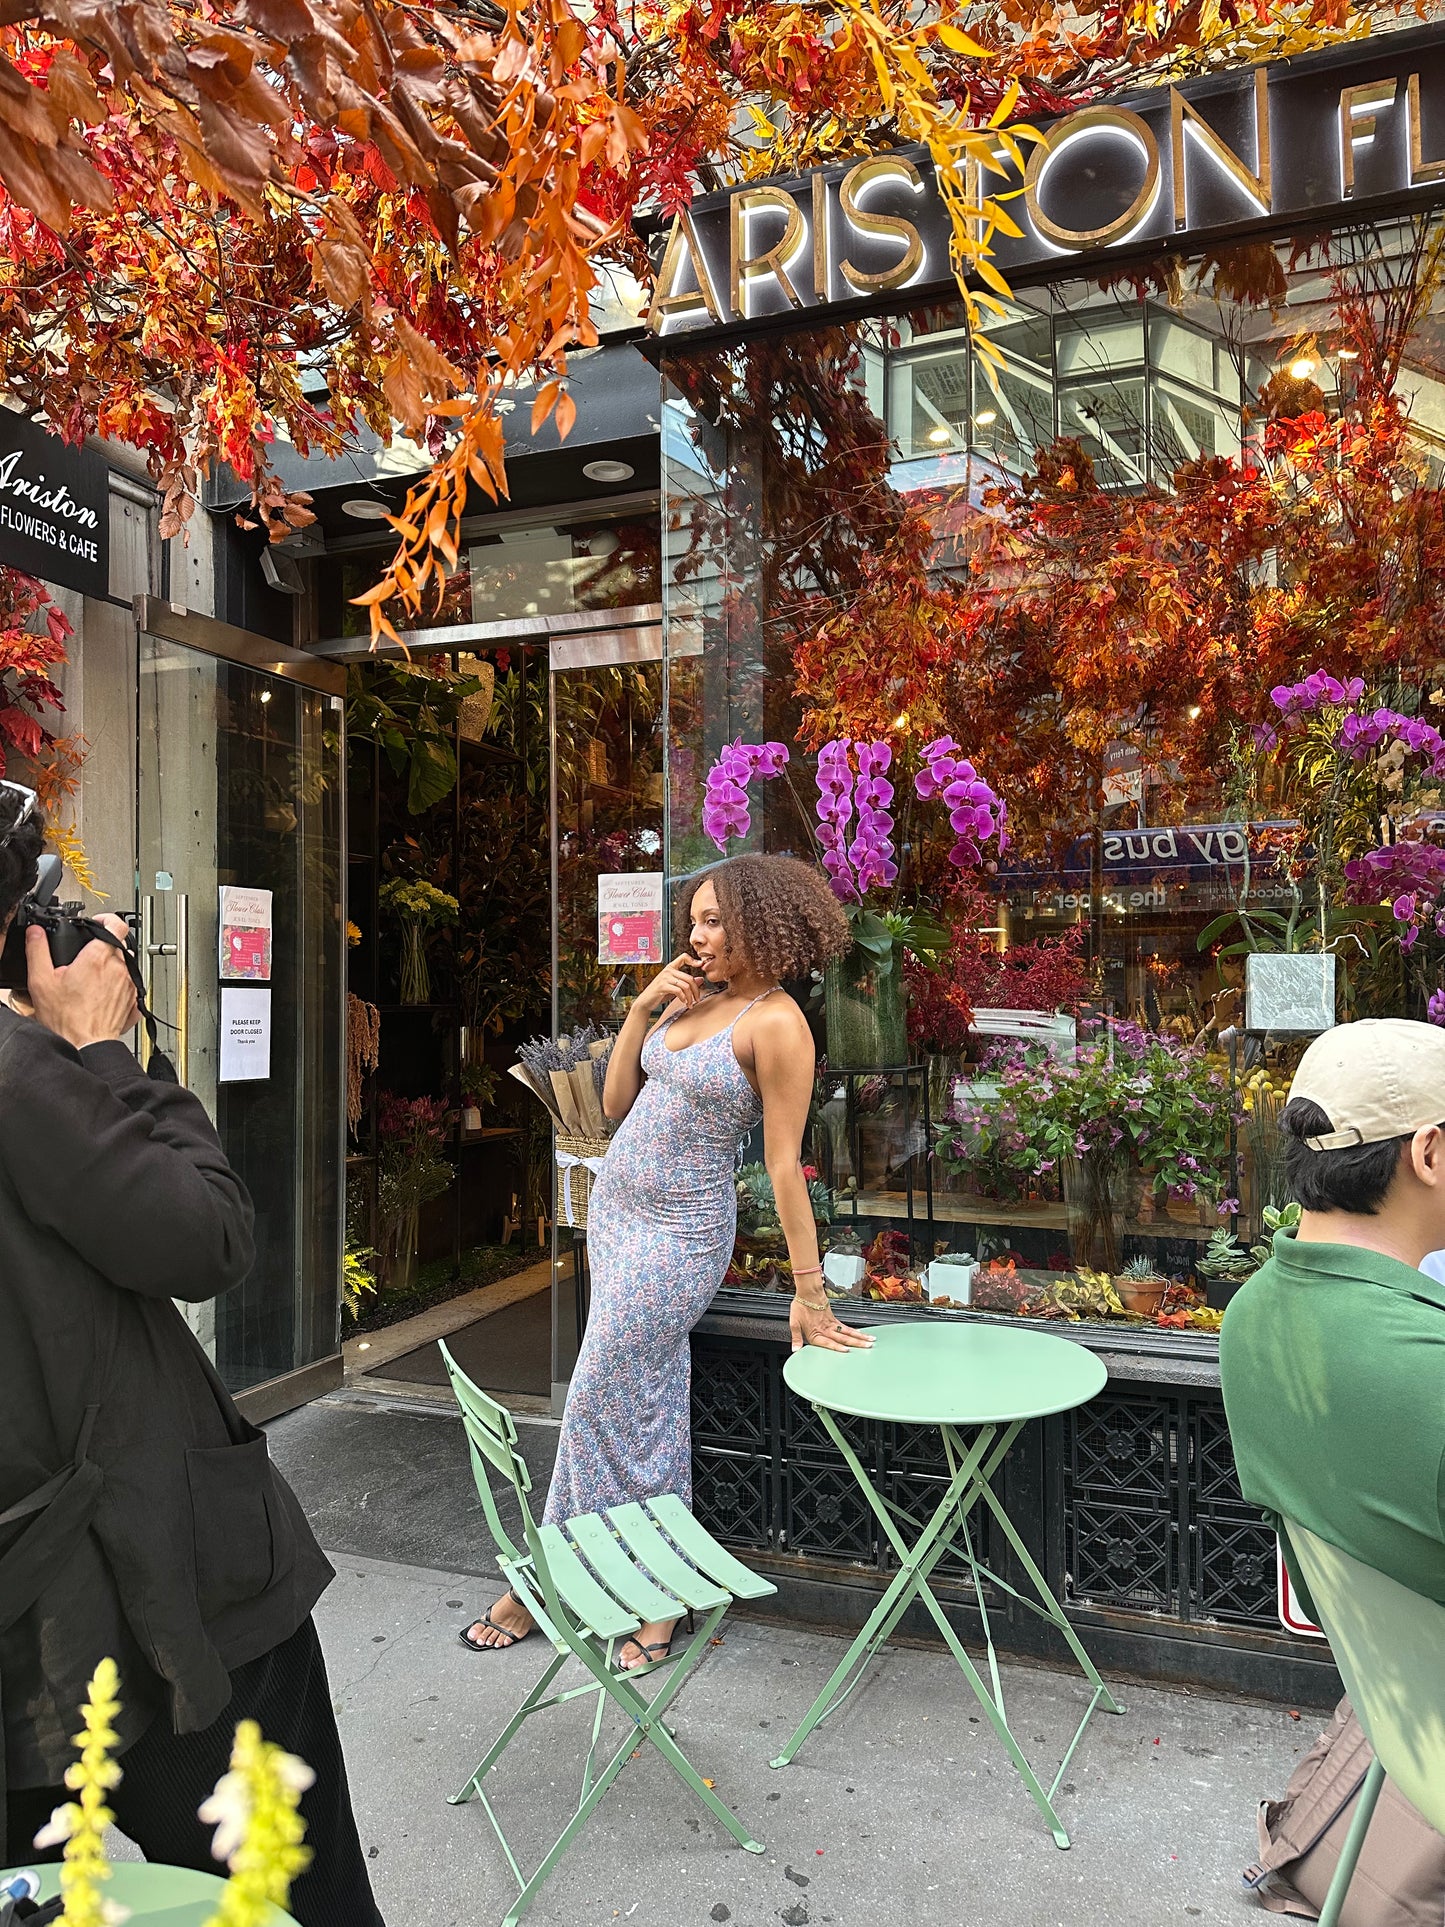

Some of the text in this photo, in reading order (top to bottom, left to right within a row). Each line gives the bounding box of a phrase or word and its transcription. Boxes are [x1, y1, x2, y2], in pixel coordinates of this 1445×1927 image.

[646, 68, 1272, 337] ARISTON
[0, 451, 99, 529] Ariston
[1, 505, 98, 563] FLOWERS & CAFE
[226, 900, 248, 913] Flower
[604, 888, 631, 900] Flower
[245, 1028, 263, 1036] CLOSED
